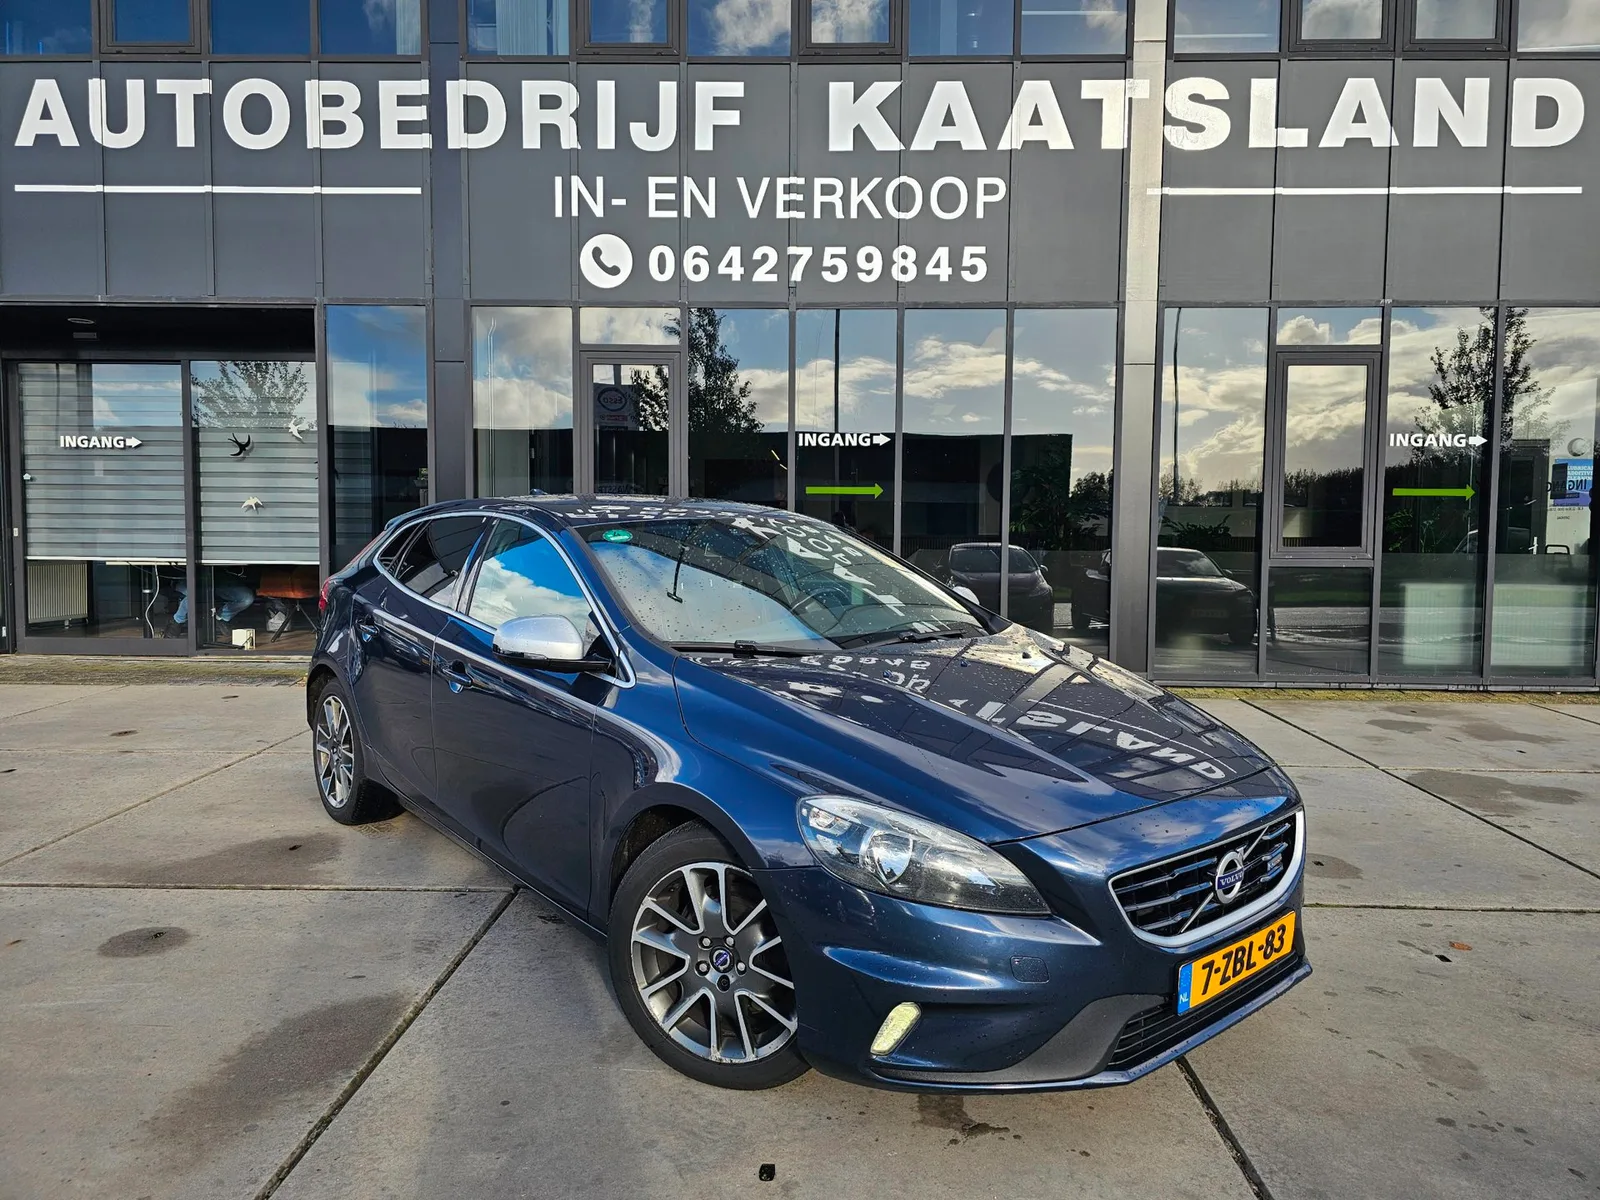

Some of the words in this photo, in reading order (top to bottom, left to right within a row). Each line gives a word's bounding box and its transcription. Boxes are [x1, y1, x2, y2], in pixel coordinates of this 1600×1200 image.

[14, 77, 745, 152] AUTOBEDRIJF
[828, 77, 1585, 152] KAATSLAND
[554, 175, 627, 218] IN-
[647, 175, 717, 219] EN
[736, 175, 1007, 220] VERKOOP
[648, 245, 989, 283] 0642759845
[60, 435, 124, 448] INGANG
[798, 433, 871, 447] INGANG
[1389, 433, 1466, 447] INGANG
[1219, 870, 1243, 886] VOLVO
[1201, 923, 1286, 996] 7-ZBL-83
[1179, 992, 1188, 1004] NL
